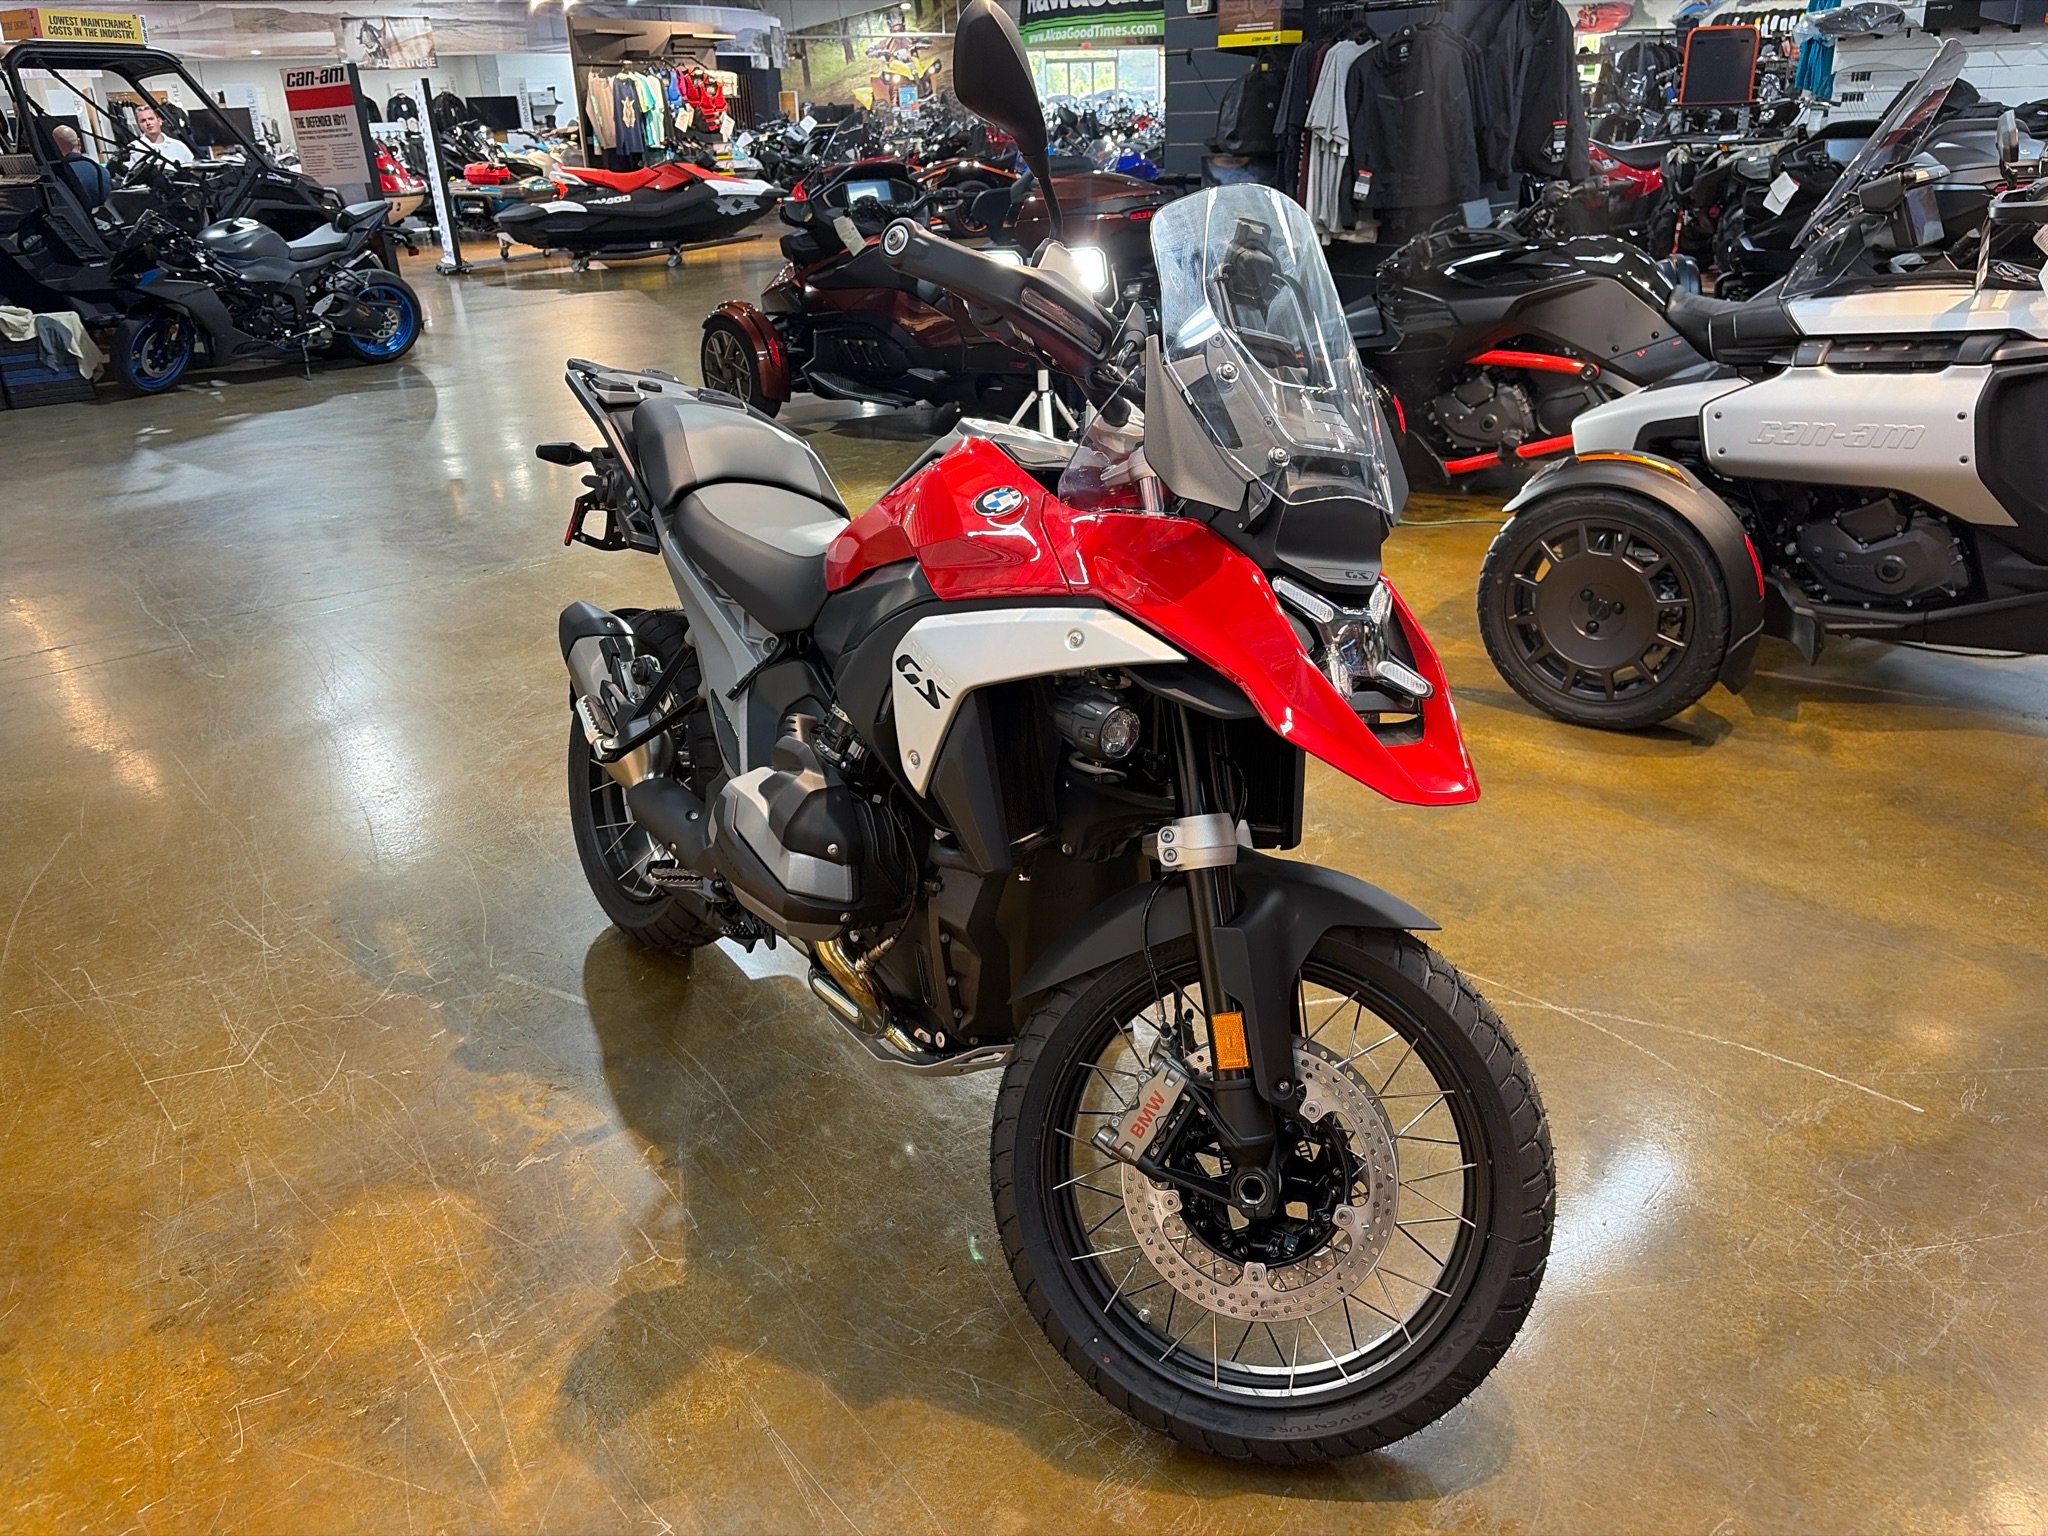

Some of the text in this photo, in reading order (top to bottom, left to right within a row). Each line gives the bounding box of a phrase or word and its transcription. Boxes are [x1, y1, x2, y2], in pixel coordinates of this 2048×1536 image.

[48, 15, 78, 26] LOWEST
[80, 17, 133, 29] MAINTENANCE
[48, 25, 138, 40] COSTS IN THE INDUSTRY.
[1028, 23, 1158, 44] www.AlcoaGoodTimes.com
[376, 57, 437, 68] ADVENTURE
[286, 66, 345, 88] can-am
[294, 116, 306, 128] THE
[306, 114, 333, 128] DEFENDER
[1748, 420, 1927, 450] can-am
[1129, 1089, 1166, 1140] BMW
